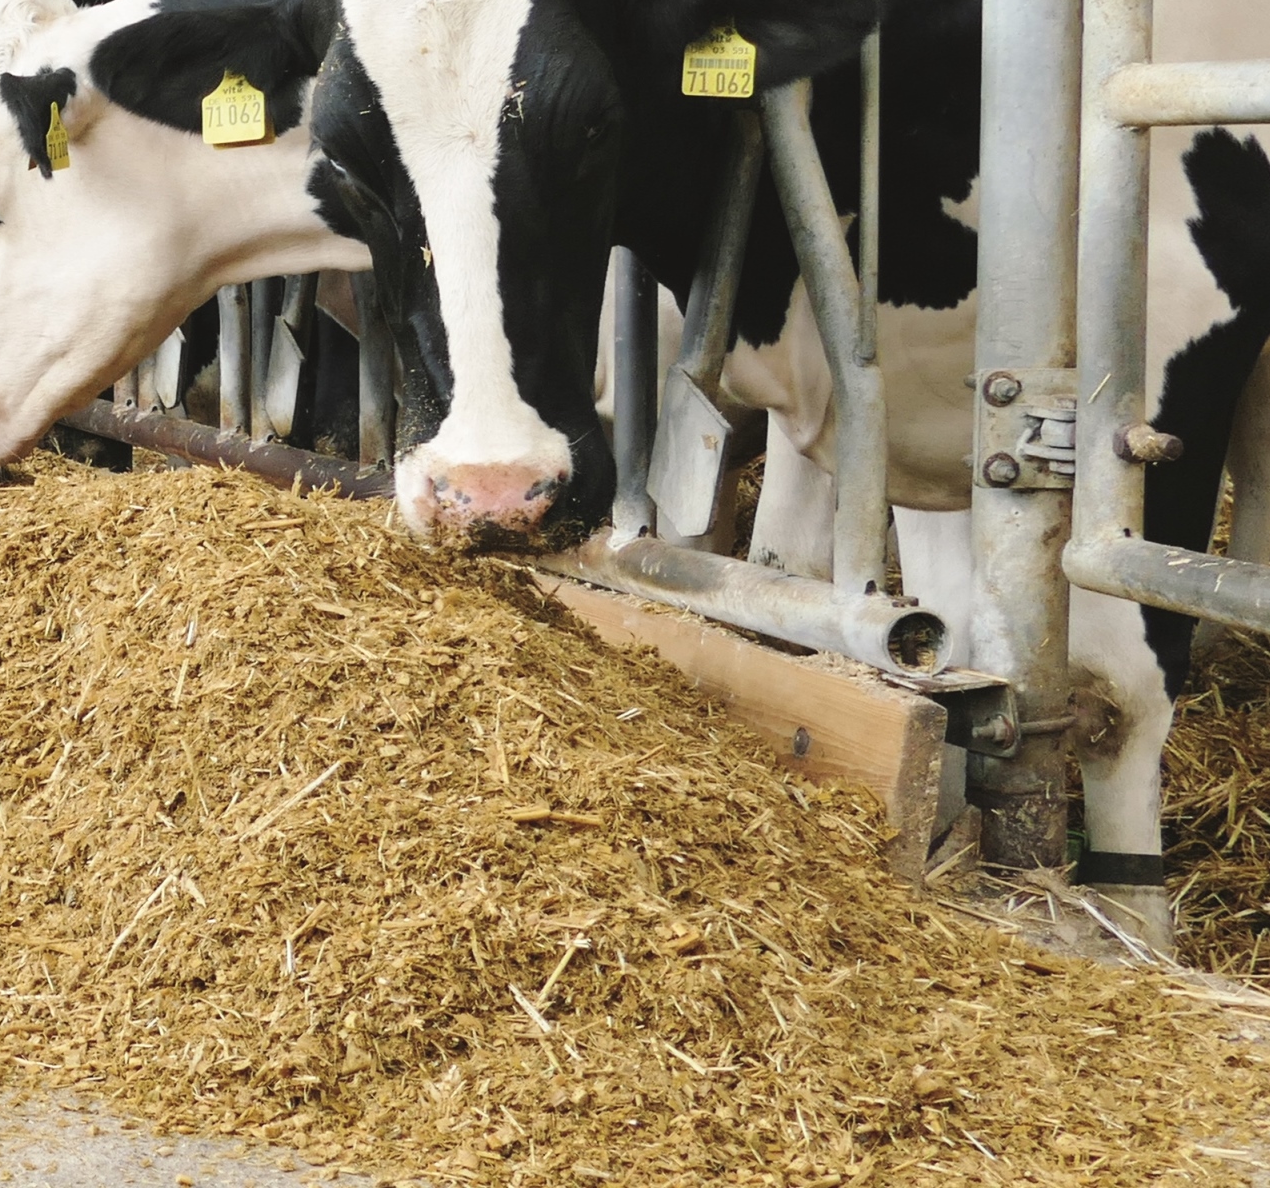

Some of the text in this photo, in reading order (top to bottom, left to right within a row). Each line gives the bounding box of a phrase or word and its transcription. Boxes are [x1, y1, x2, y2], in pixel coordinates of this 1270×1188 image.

[712, 46, 726, 54] 03
[732, 46, 749, 55] 591
[687, 71, 751, 94] 71 062
[241, 94, 257, 102] 591
[205, 101, 262, 128] 71 062
